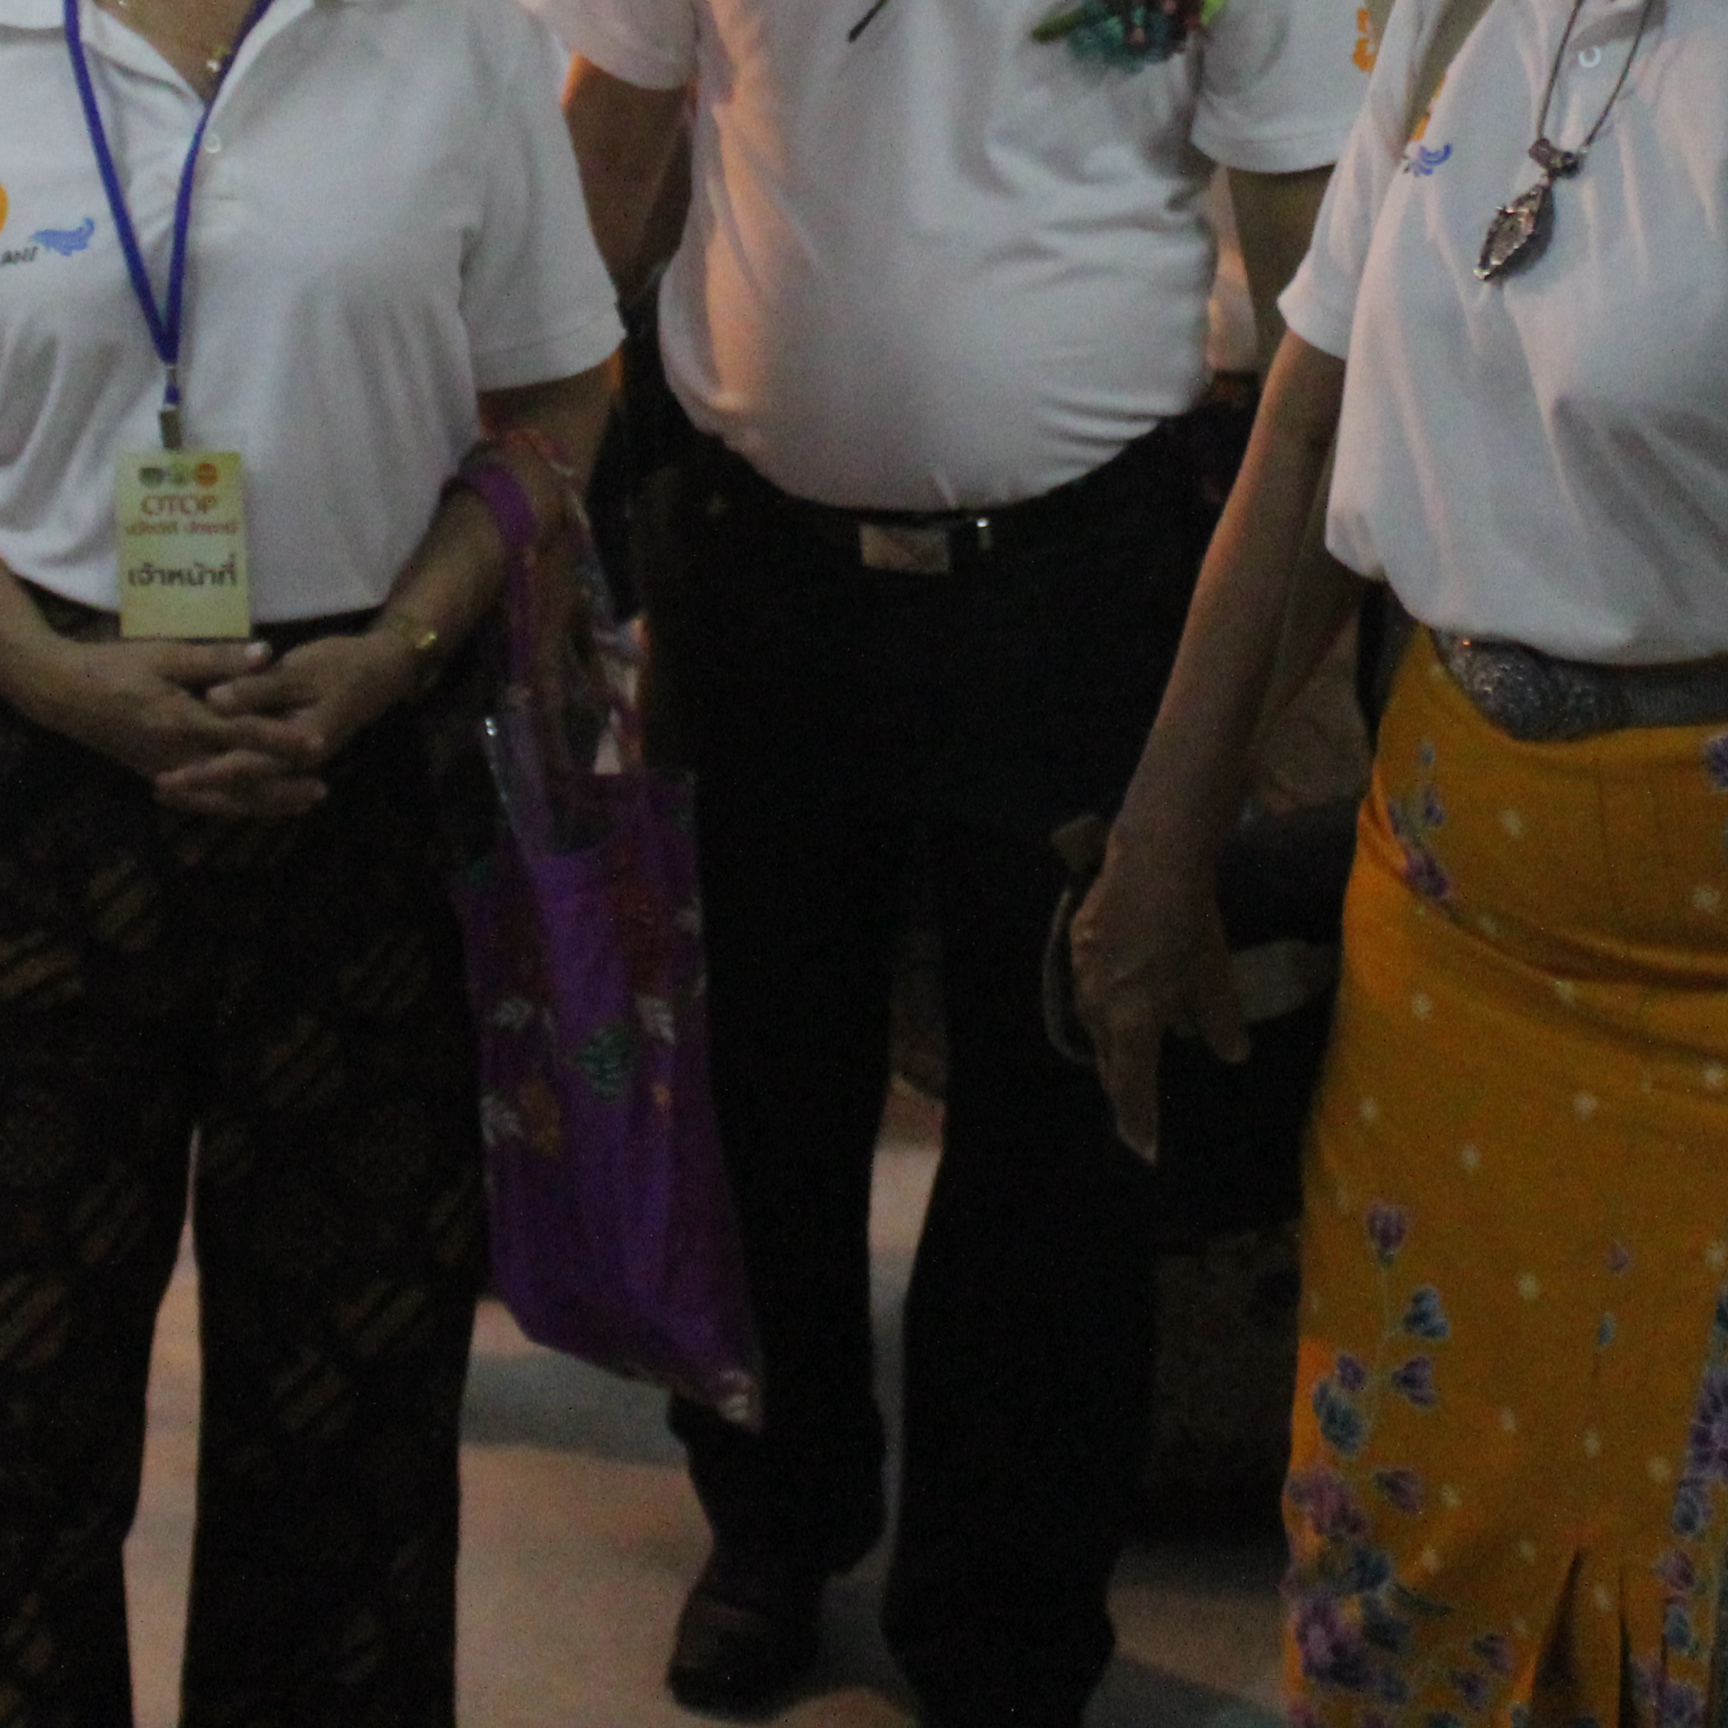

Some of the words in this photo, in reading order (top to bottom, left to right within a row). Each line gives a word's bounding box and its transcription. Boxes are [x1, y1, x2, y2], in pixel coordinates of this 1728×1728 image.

[128, 554, 238, 587] เจ้าหน้าที่
